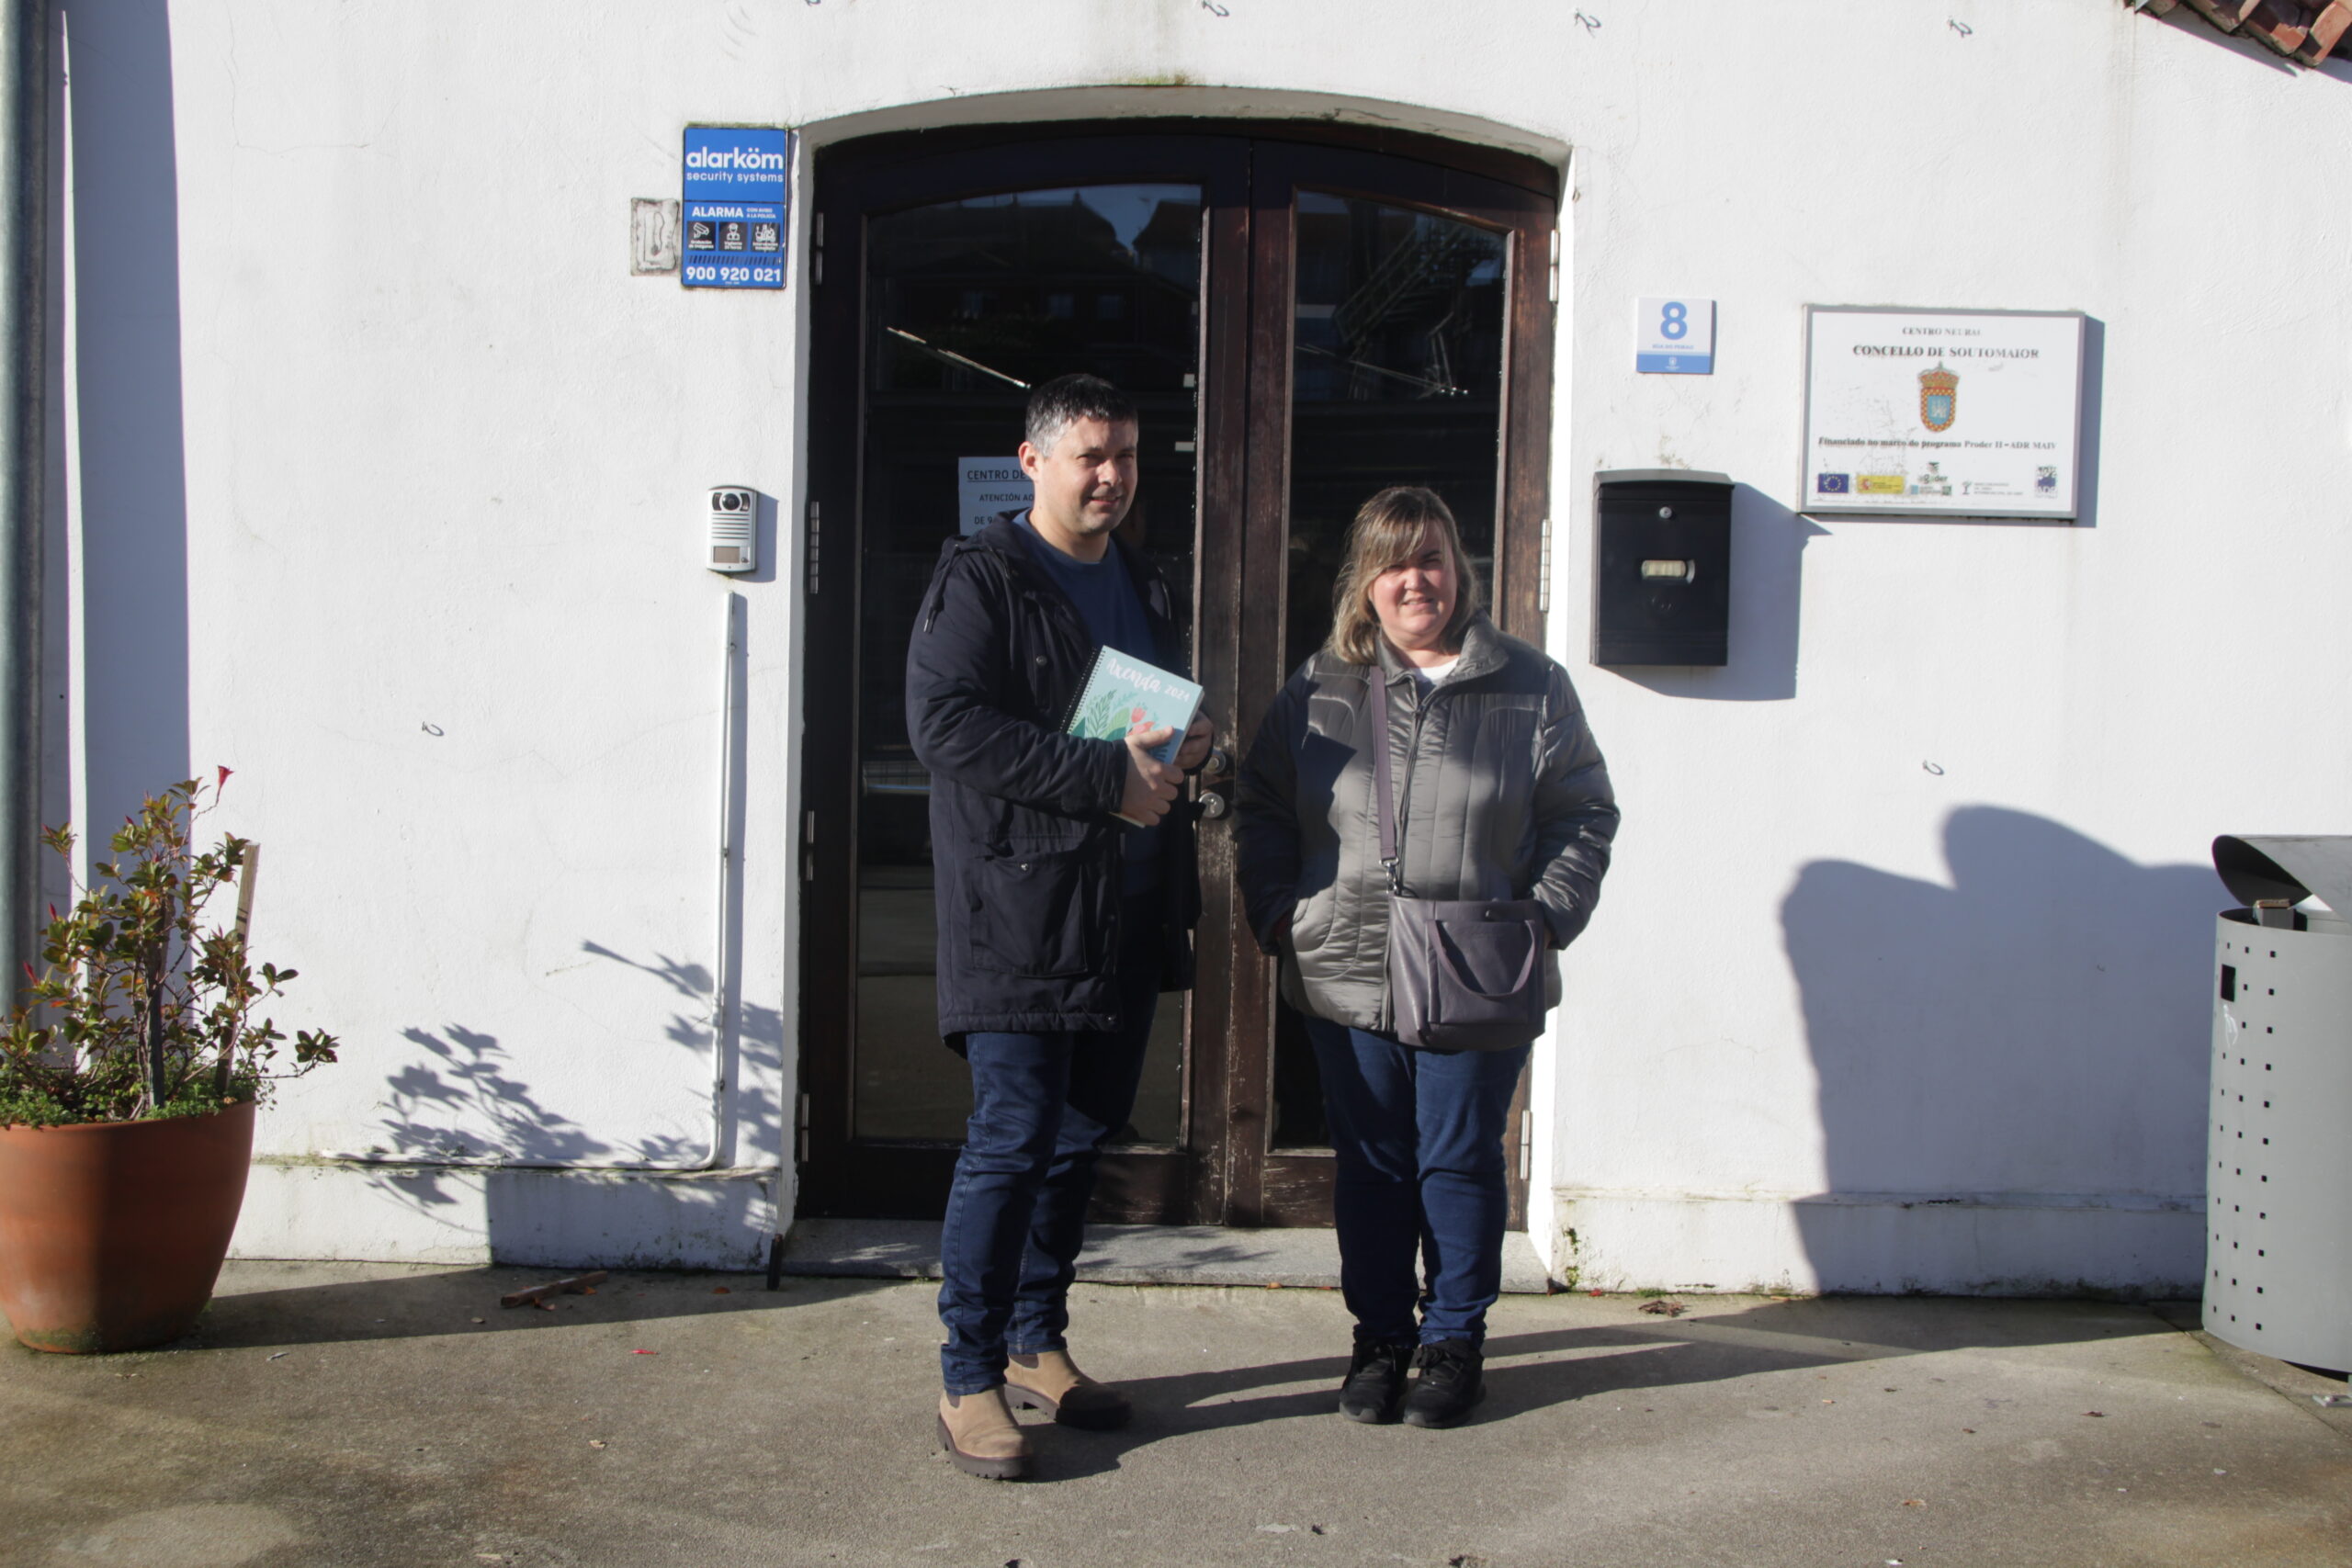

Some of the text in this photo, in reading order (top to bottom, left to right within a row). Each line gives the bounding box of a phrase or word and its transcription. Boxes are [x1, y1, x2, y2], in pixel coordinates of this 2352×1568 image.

[686, 146, 784, 169] alarköm
[686, 171, 784, 184] security systems
[692, 207, 744, 219] ALARMA
[686, 266, 781, 282] 900 920 021
[1660, 300, 1688, 341] 8
[1902, 327, 1942, 335] CENTRO
[1853, 344, 2039, 358] CONCELLO DE SOUTOMAIOR
[1818, 435, 1866, 446] Financiado
[1867, 438, 1879, 446] no
[1880, 439, 1906, 447] marco
[1907, 439, 1919, 447] do
[1921, 440, 1962, 449] programa
[1964, 439, 1992, 448] Proder
[967, 469, 1025, 479] CENTRO DE
[978, 492, 1021, 502] ATENCIÓN
[974, 516, 985, 525] DE
[1106, 657, 1191, 702] Axenda 2024
